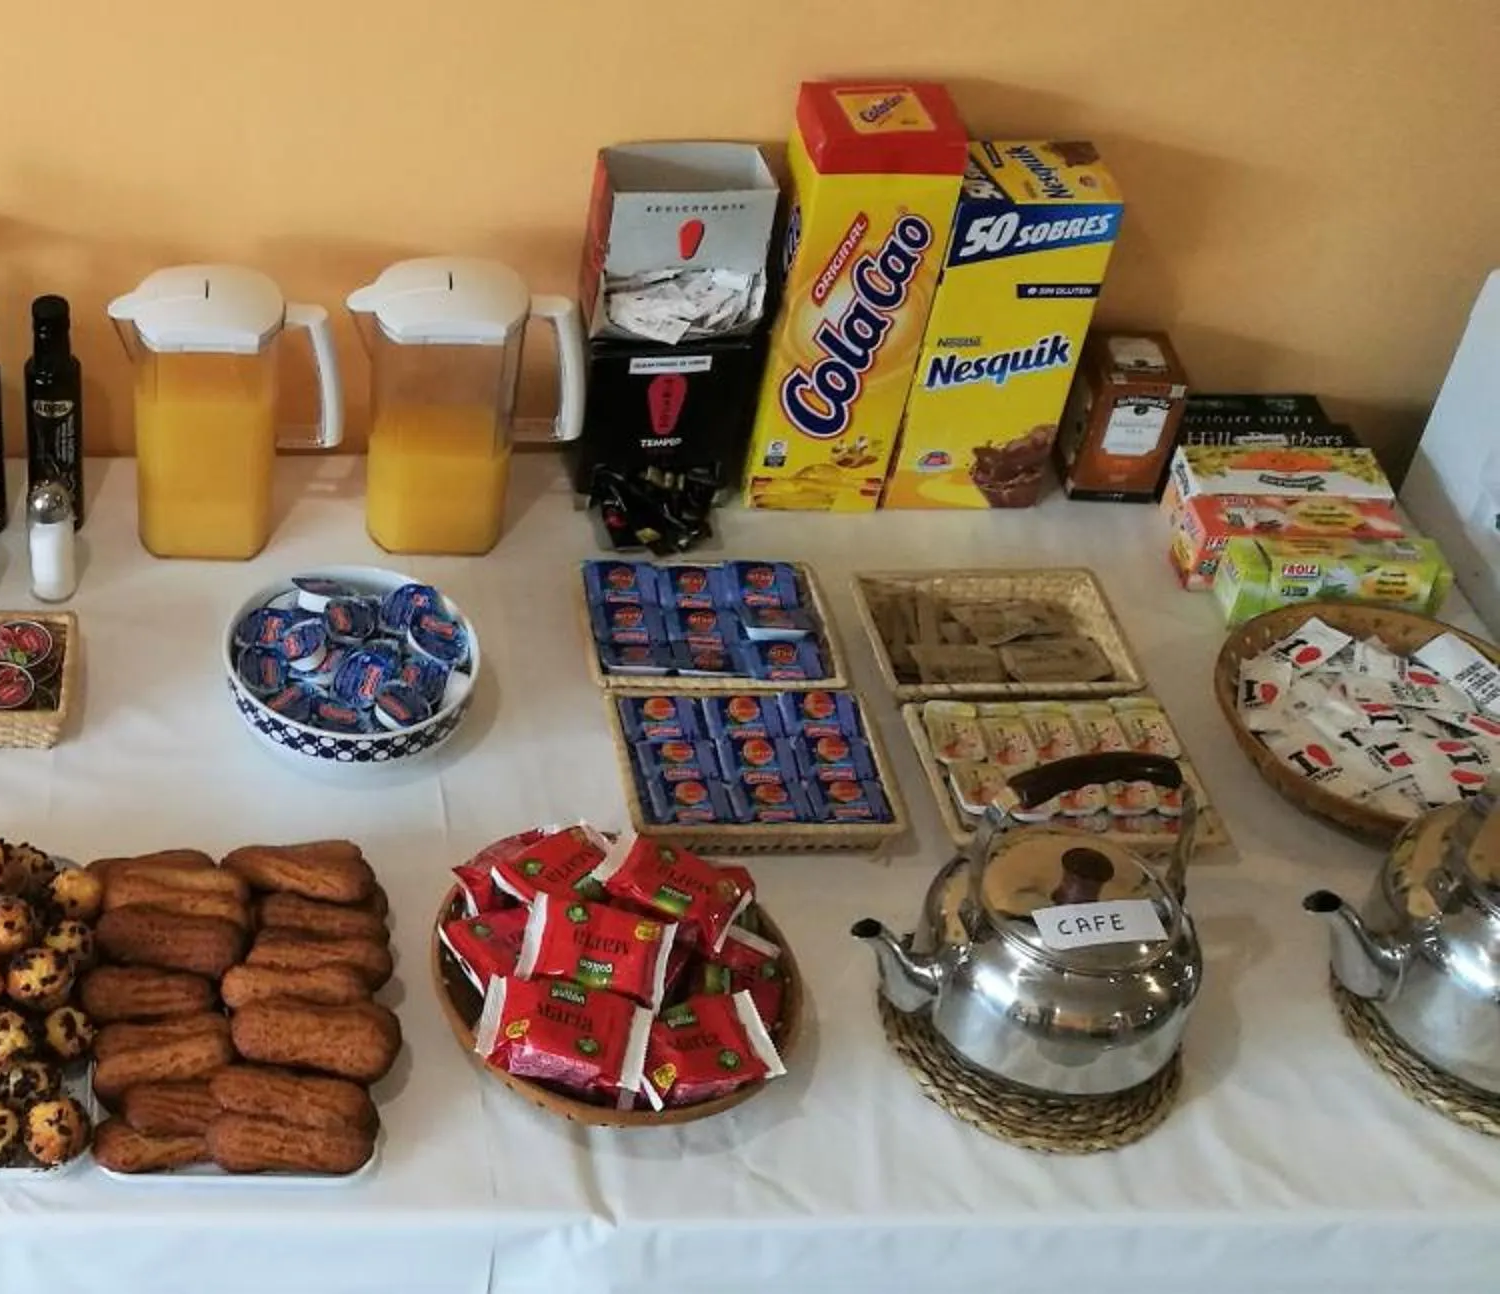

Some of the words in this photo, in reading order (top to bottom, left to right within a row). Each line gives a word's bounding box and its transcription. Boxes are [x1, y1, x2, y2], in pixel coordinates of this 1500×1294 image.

[814, 218, 867, 299] ORIGINAL
[959, 211, 1021, 257] 50
[1014, 213, 1115, 247] SOBRES
[781, 214, 933, 438] ColaCao
[925, 334, 1071, 389] Nesquik
[1057, 913, 1125, 935] CAFE
